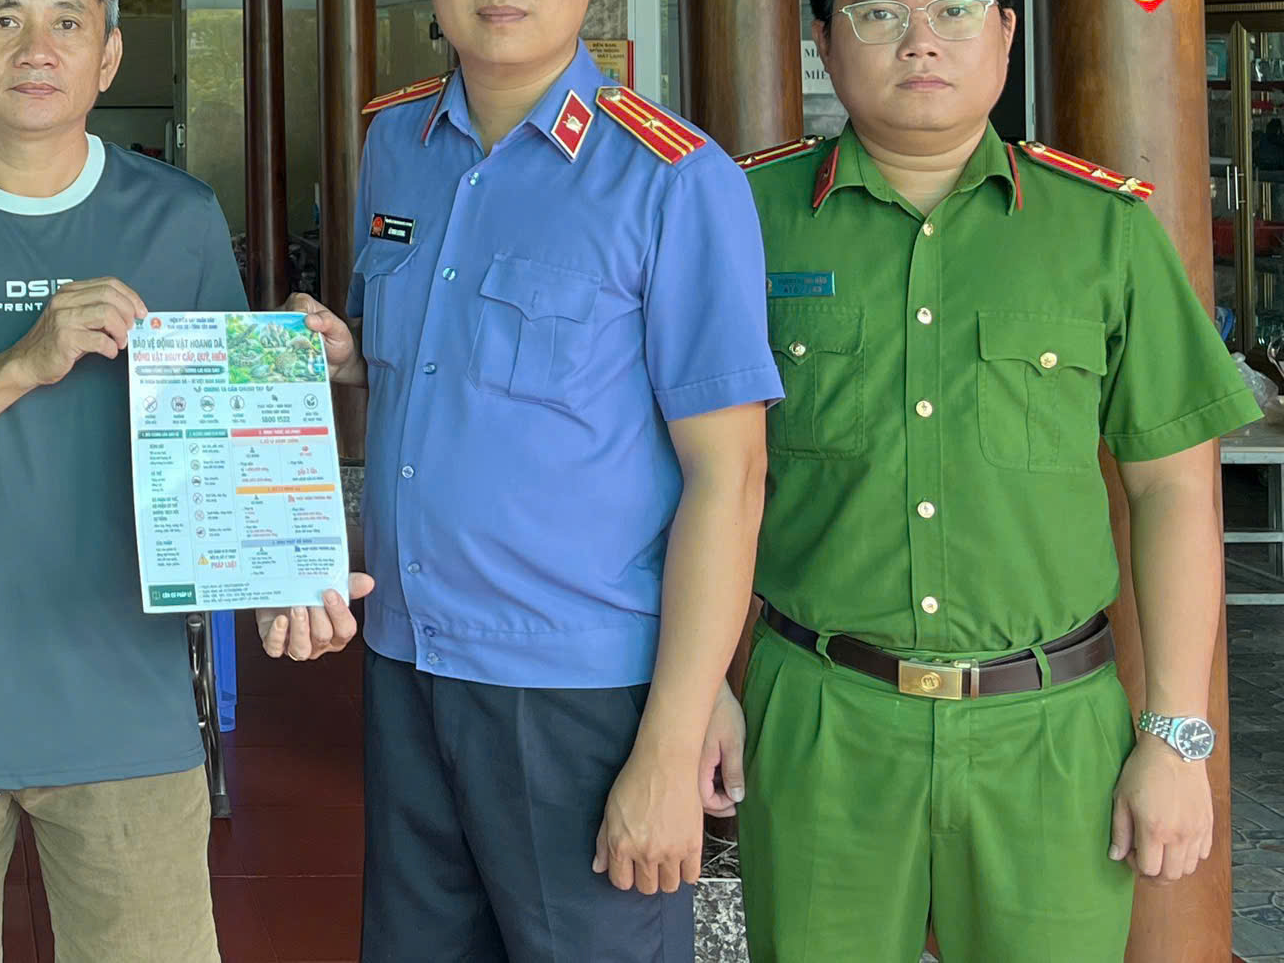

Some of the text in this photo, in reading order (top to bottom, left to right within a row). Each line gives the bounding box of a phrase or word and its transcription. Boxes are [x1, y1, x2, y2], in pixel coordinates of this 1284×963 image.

[147, 337, 155, 350] VỆ
[176, 337, 188, 350] VẬT
[190, 338, 212, 348] HOANG
